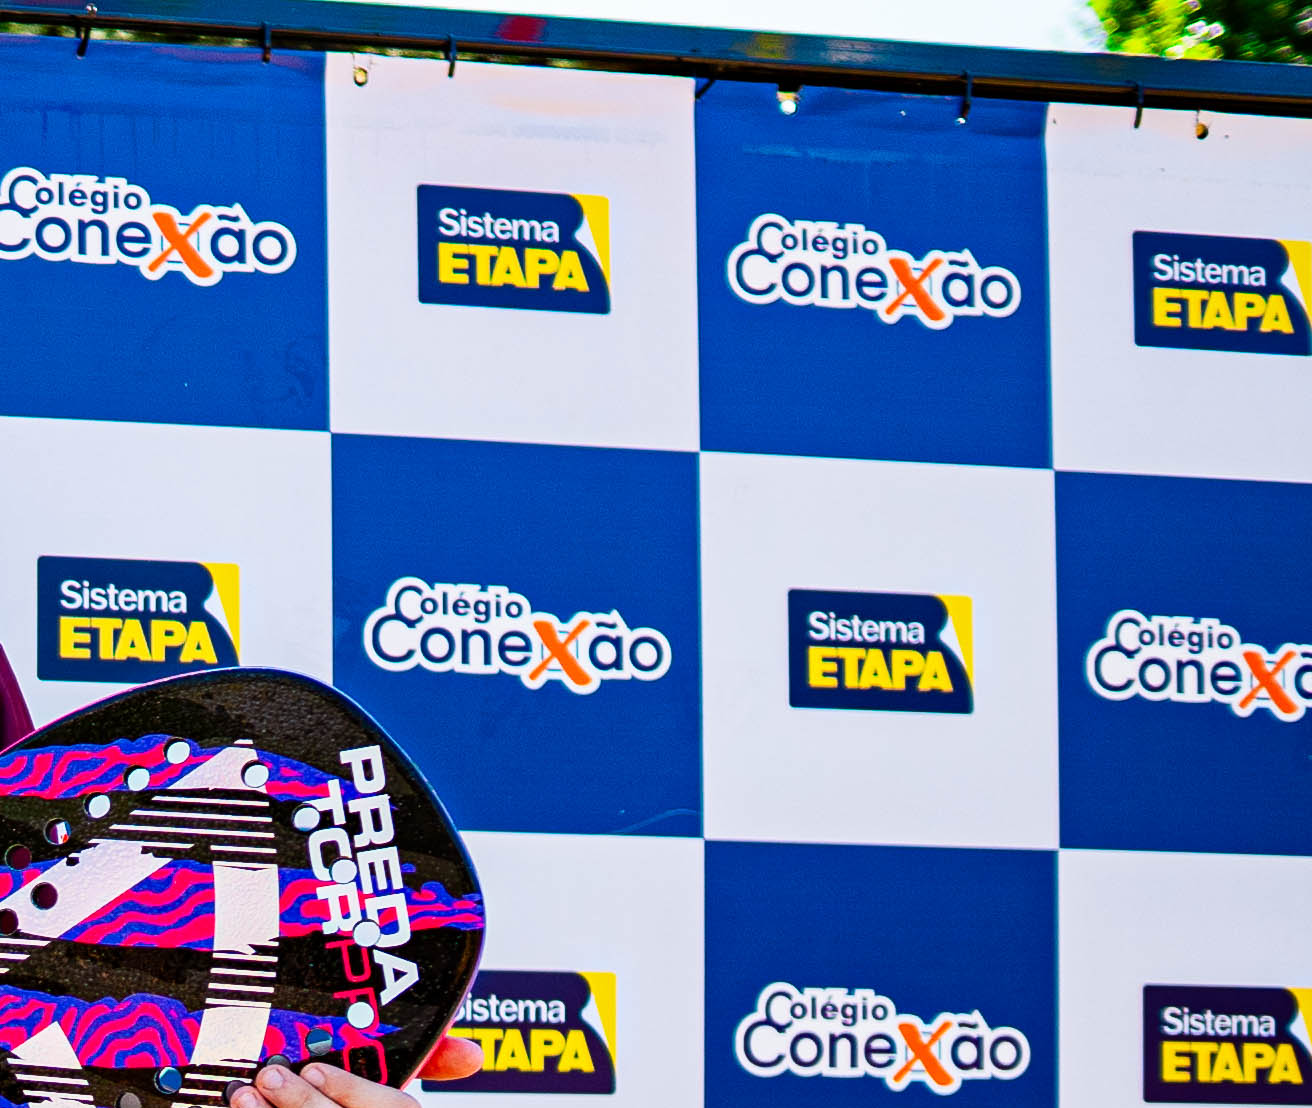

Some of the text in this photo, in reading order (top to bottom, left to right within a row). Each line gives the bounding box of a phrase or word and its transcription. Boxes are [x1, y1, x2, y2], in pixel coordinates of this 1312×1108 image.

[9, 176, 141, 218] Colégio
[438, 209, 560, 242] Sistema
[756, 222, 878, 263] Colégio
[438, 243, 589, 292] ETAPA
[1153, 255, 1266, 286] Sistema
[1152, 288, 1294, 333] ETAPA
[60, 581, 187, 613] Sistema
[396, 586, 523, 627] Colégio
[59, 617, 217, 664] ETAPA
[809, 612, 925, 644] Sistema
[1115, 618, 1233, 657] Colégio
[808, 647, 953, 692] ETAPA
[764, 992, 888, 1029] Colégio
[1163, 1007, 1276, 1036] Sistema
[446, 1028, 595, 1073] TAPA
[1162, 1041, 1304, 1084] ETAPA
